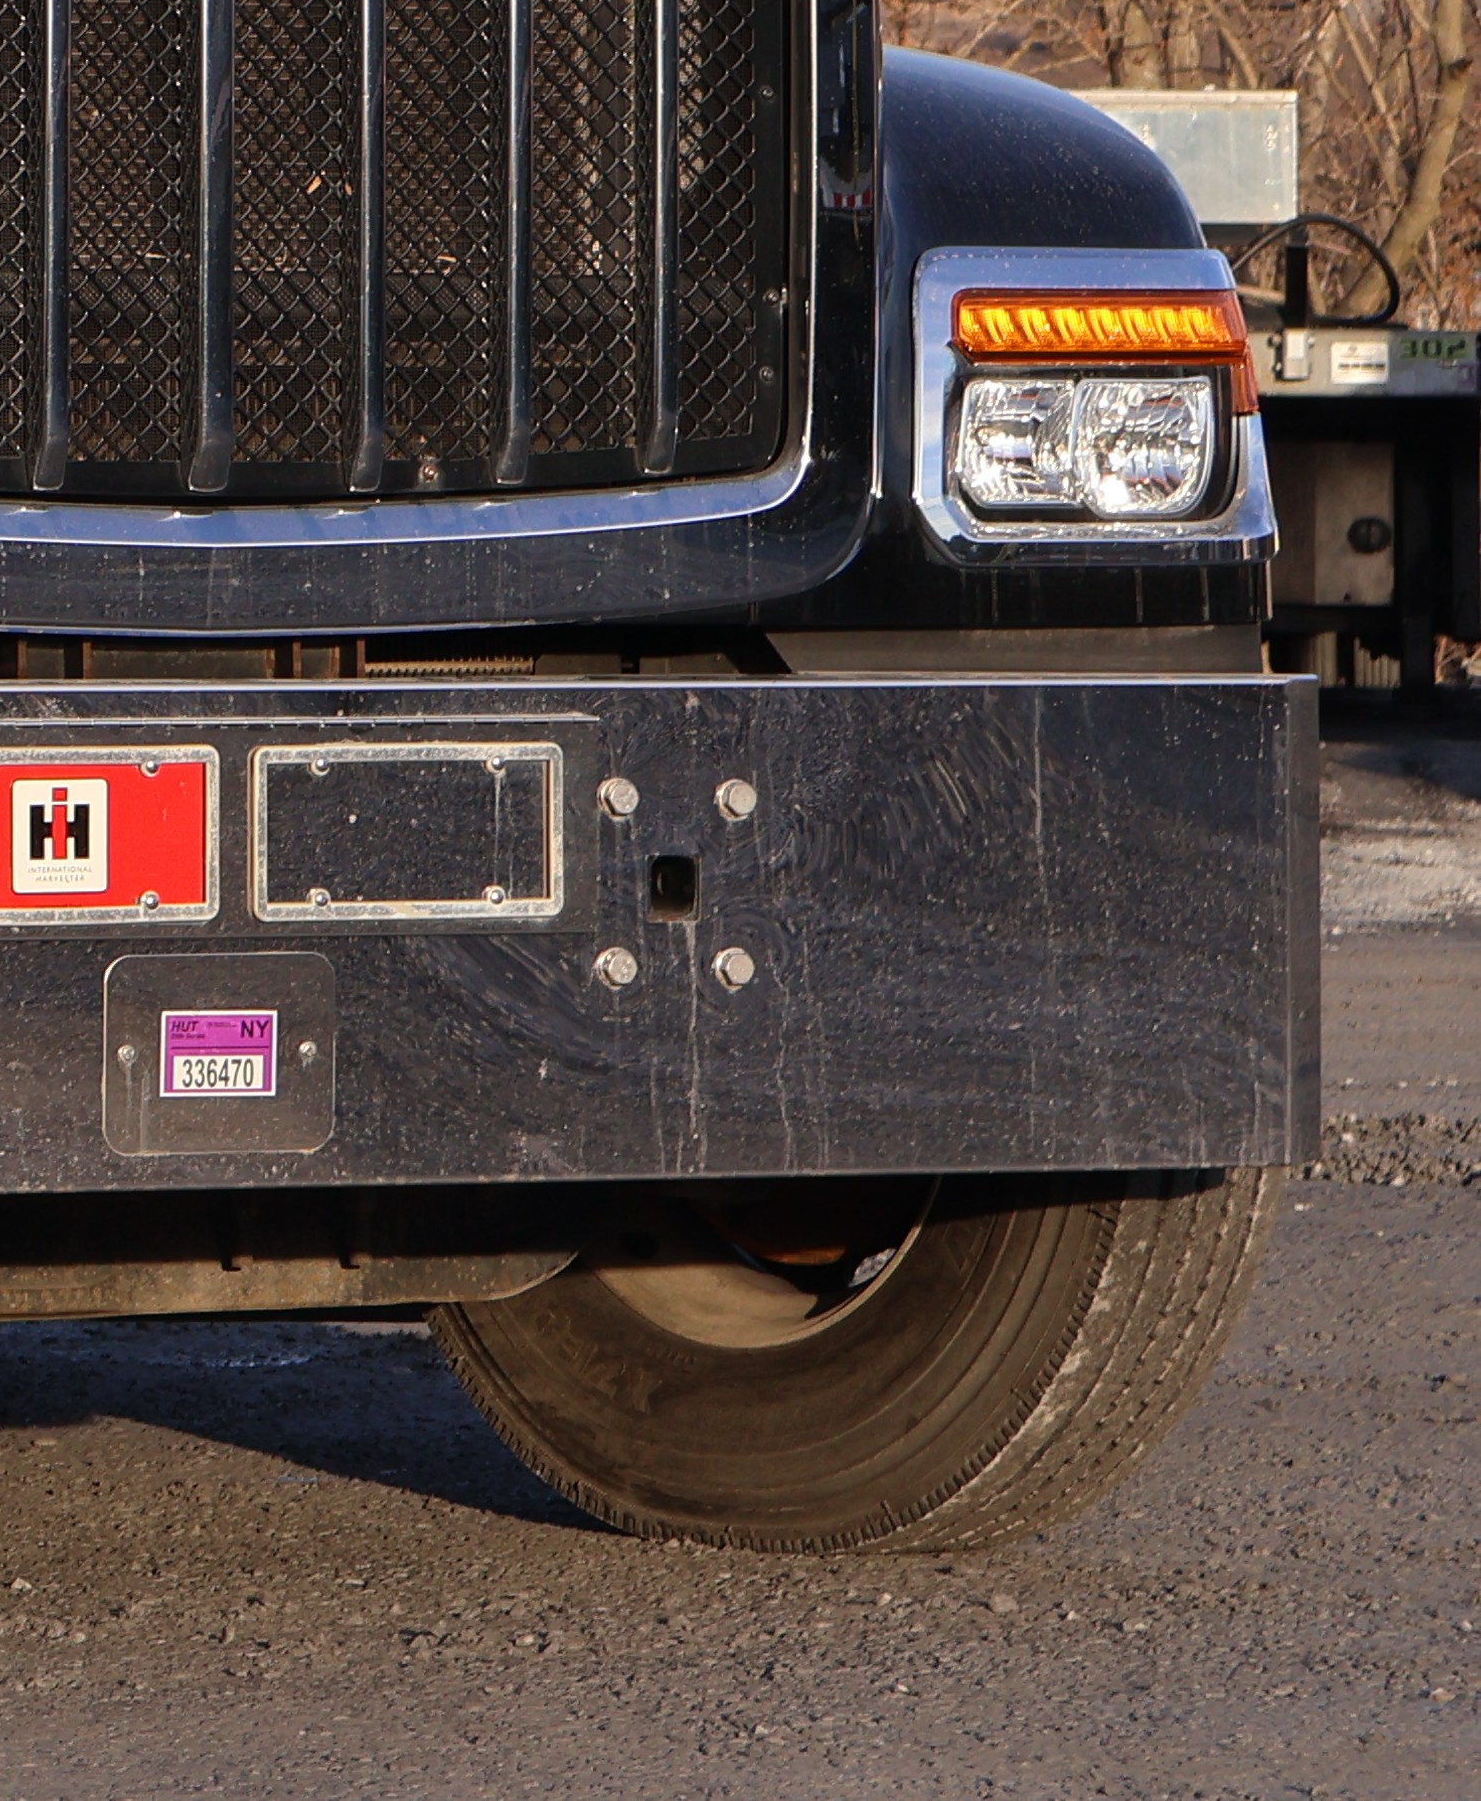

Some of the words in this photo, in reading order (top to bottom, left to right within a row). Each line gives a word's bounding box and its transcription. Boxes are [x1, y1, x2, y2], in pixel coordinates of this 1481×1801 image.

[36, 874, 85, 883] HARVESTER
[171, 1021, 198, 1031] HUT
[240, 1020, 269, 1038] NY
[182, 1059, 254, 1087] 336470
